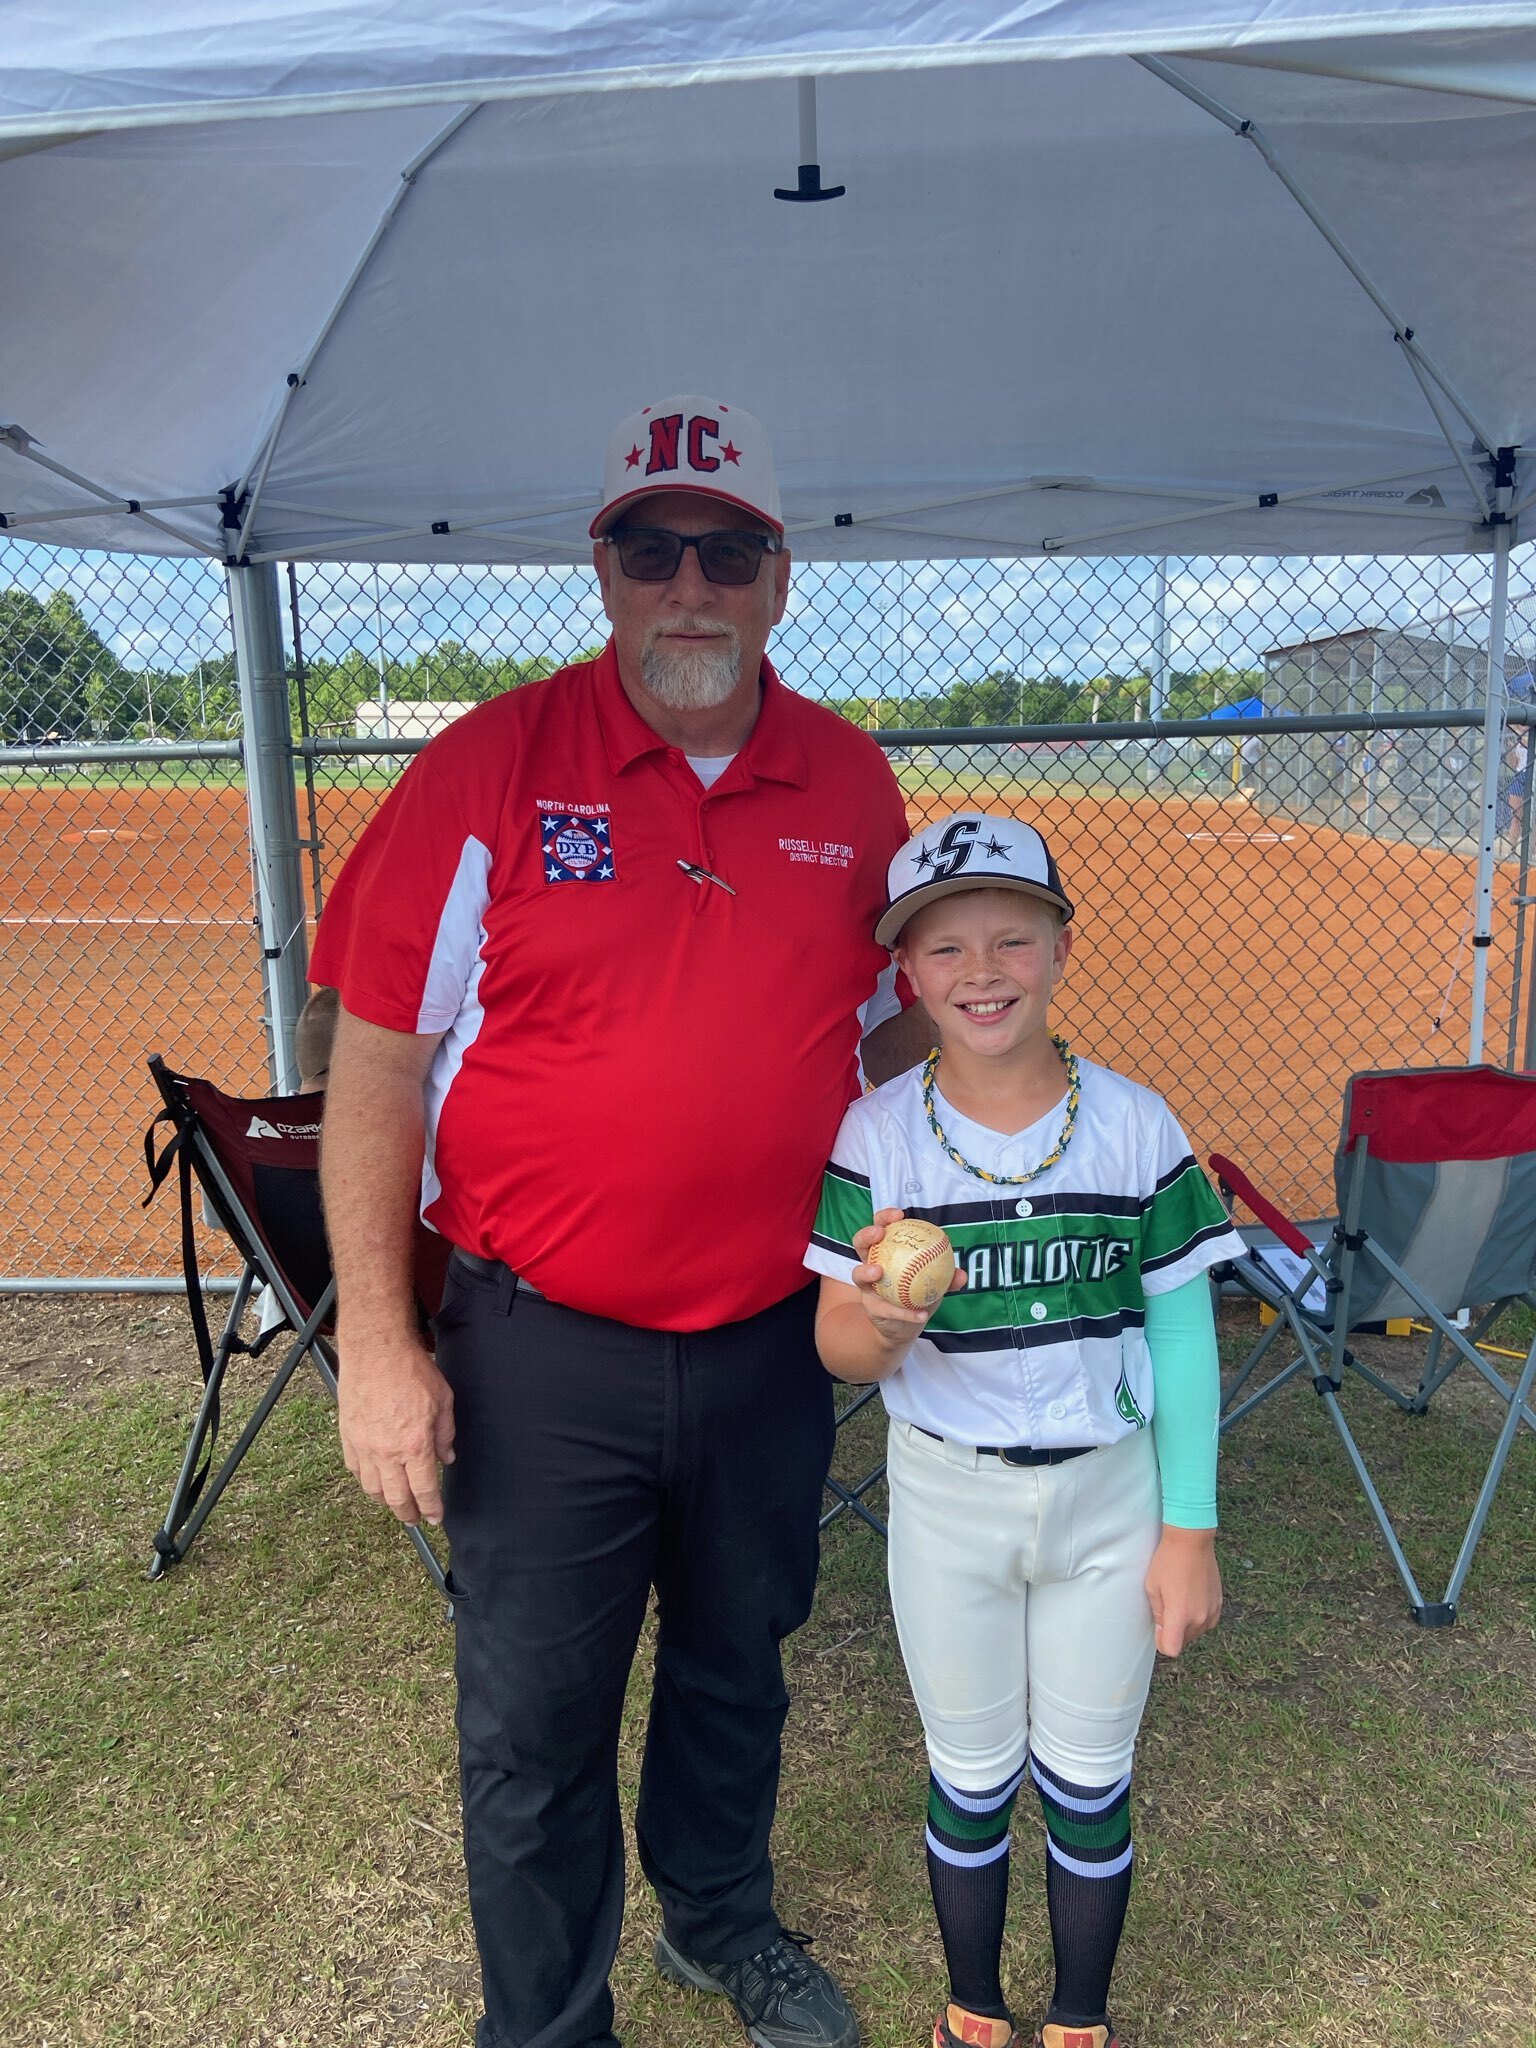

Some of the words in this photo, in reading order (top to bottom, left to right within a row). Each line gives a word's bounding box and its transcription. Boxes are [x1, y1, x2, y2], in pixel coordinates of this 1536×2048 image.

[645, 413, 720, 477] NC
[536, 799, 565, 811] NORTH
[567, 803, 612, 815] CAROLINA
[557, 841, 596, 855] DYB
[778, 838, 819, 853] RUSSELL
[931, 819, 981, 881] S
[789, 852, 819, 863] DISTRICT
[819, 855, 848, 868] DIRECTOR
[954, 1234, 1133, 1294] ALLOTTE
